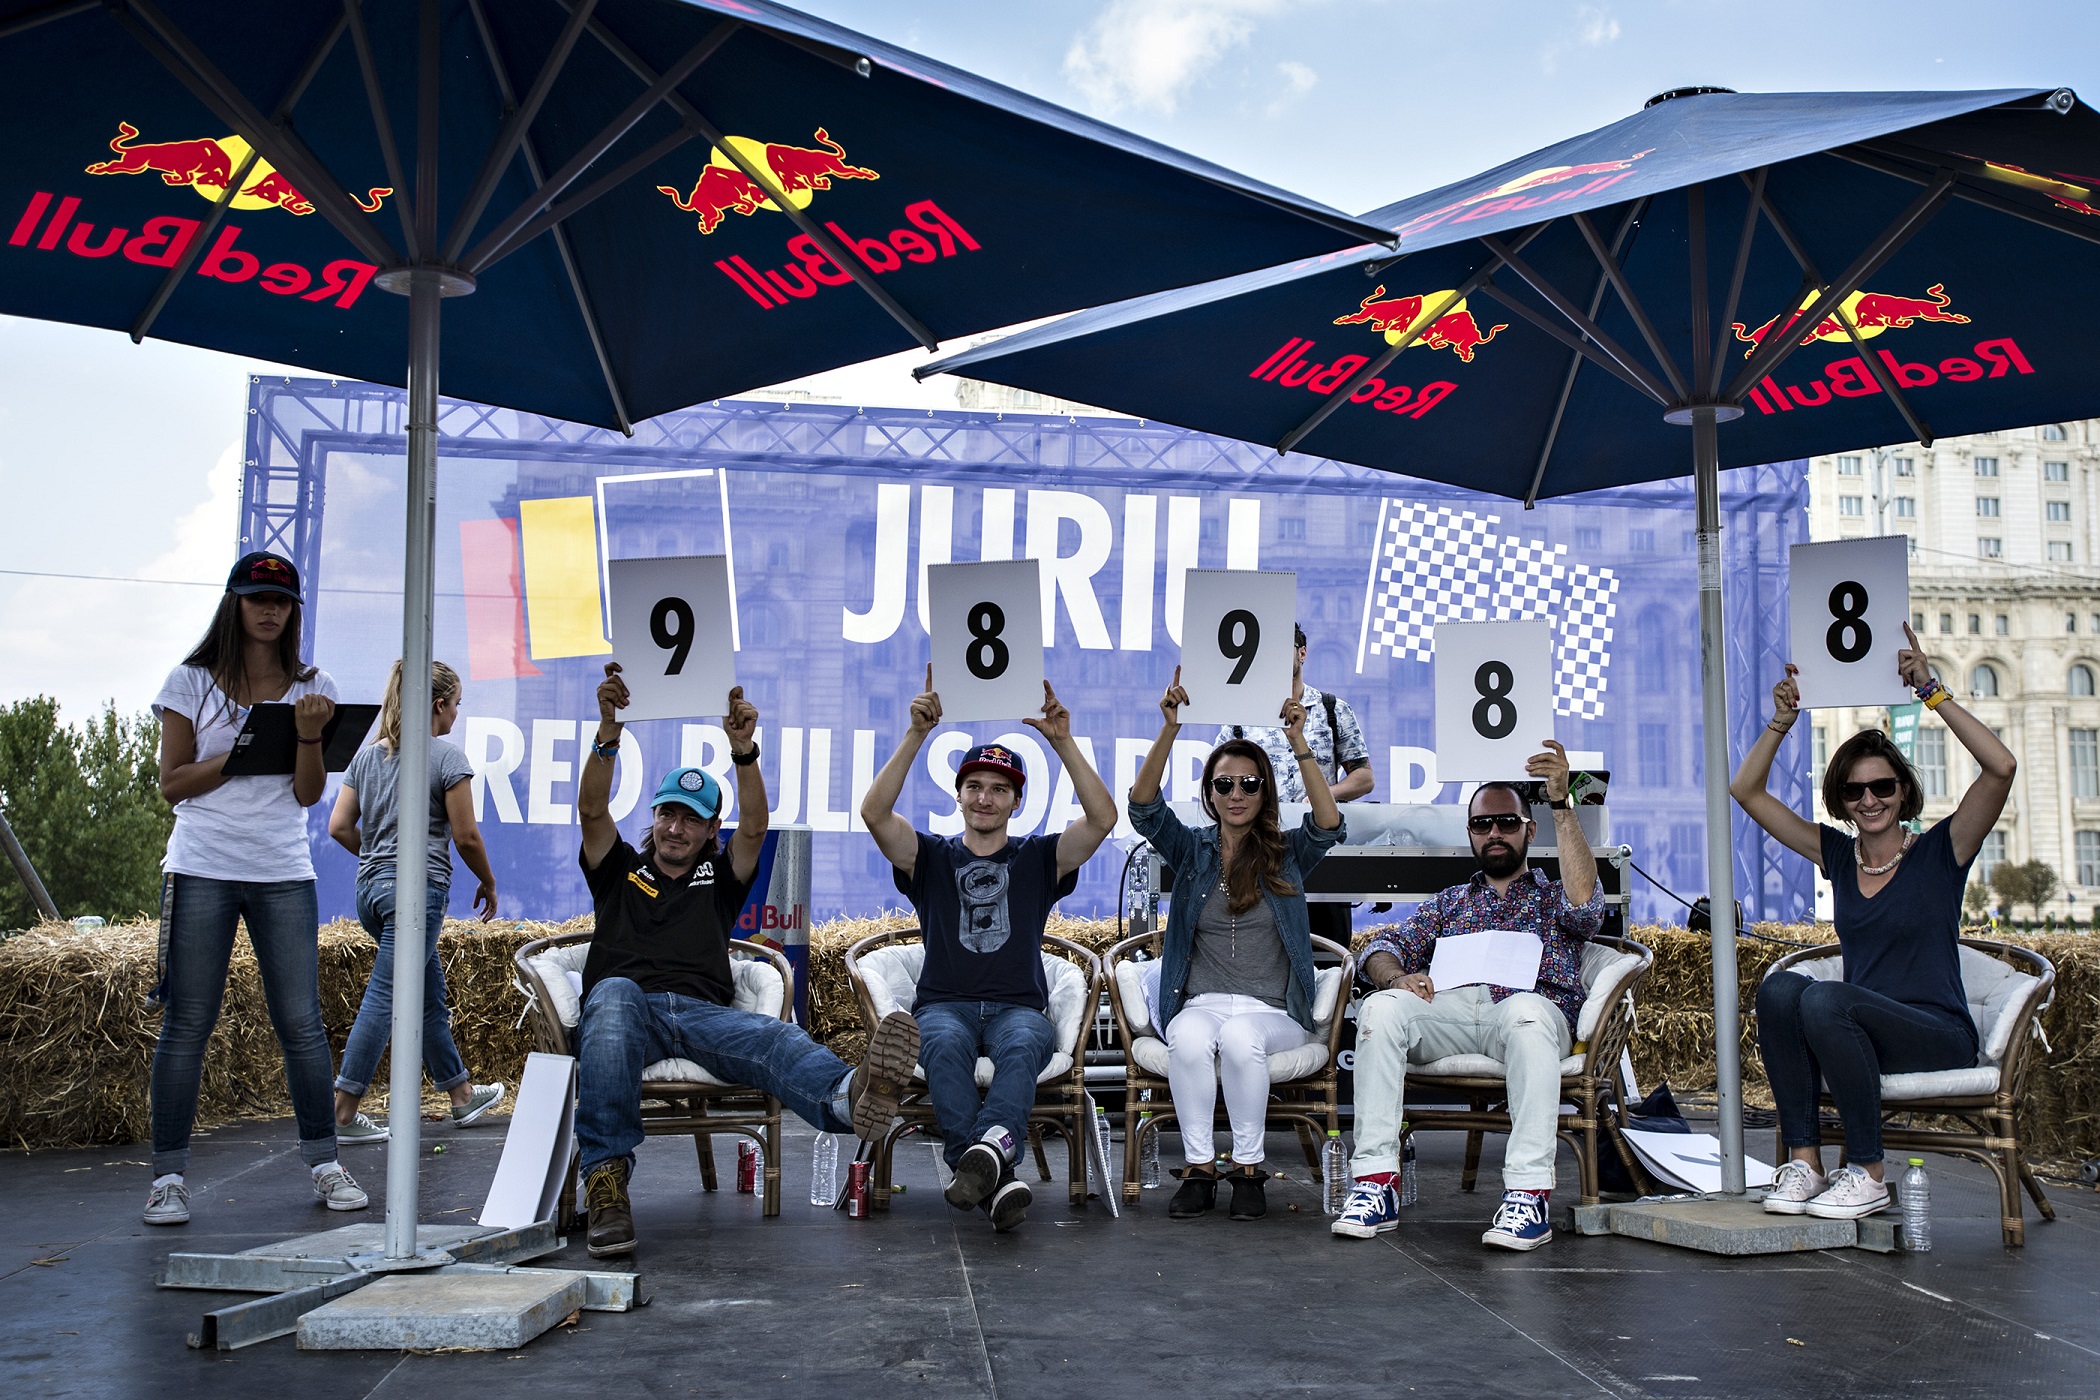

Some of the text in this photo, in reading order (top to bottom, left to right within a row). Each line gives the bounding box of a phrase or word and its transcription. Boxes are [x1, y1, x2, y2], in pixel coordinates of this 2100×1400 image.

[649, 596, 696, 676] 9
[965, 601, 1010, 680] 8
[1217, 609, 1261, 685] 9
[1825, 580, 1873, 664] 8
[1471, 660, 1518, 740] 8
[465, 715, 644, 826] RED
[680, 723, 878, 833] BULL
[761, 904, 803, 930] Bull
